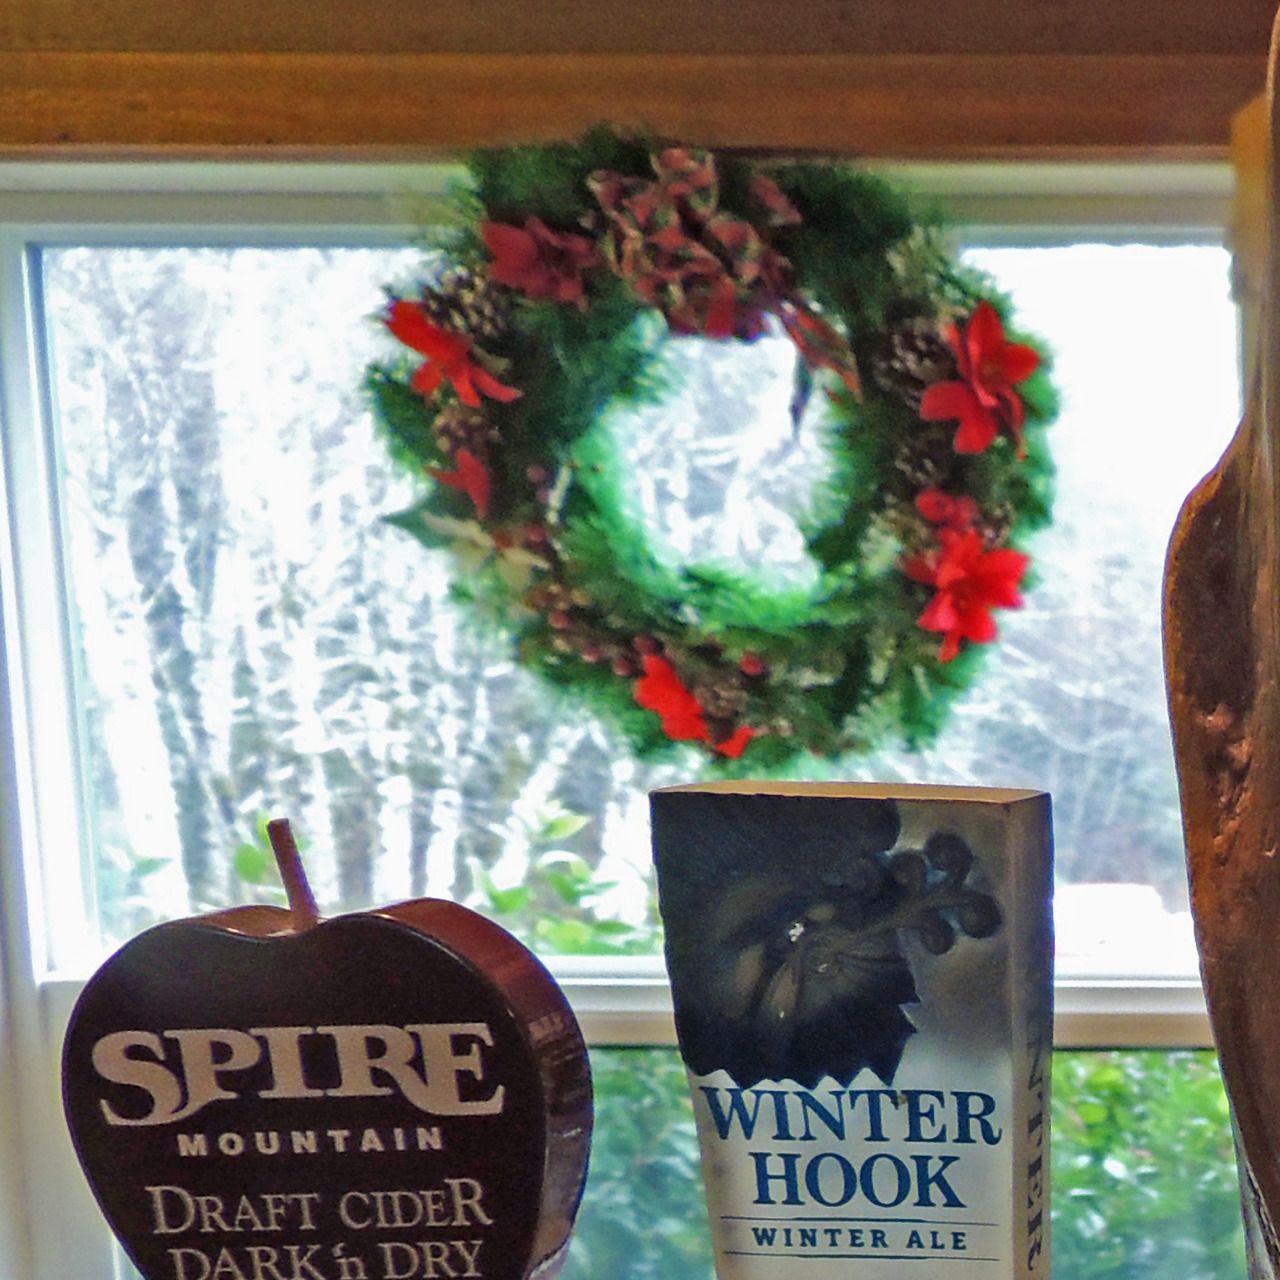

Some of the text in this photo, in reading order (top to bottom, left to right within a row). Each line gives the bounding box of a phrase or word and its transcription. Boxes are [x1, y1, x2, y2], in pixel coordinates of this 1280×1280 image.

[91, 1022, 505, 1127] SPIRE
[177, 1126, 444, 1157] MOUNTAIN
[699, 1086, 1003, 1146] WINTER
[145, 1178, 494, 1235] DRAFT CIDER
[748, 1151, 968, 1209] HOOK
[378, 1240, 484, 1280] DRY
[751, 1226, 969, 1251] WINTER ALE
